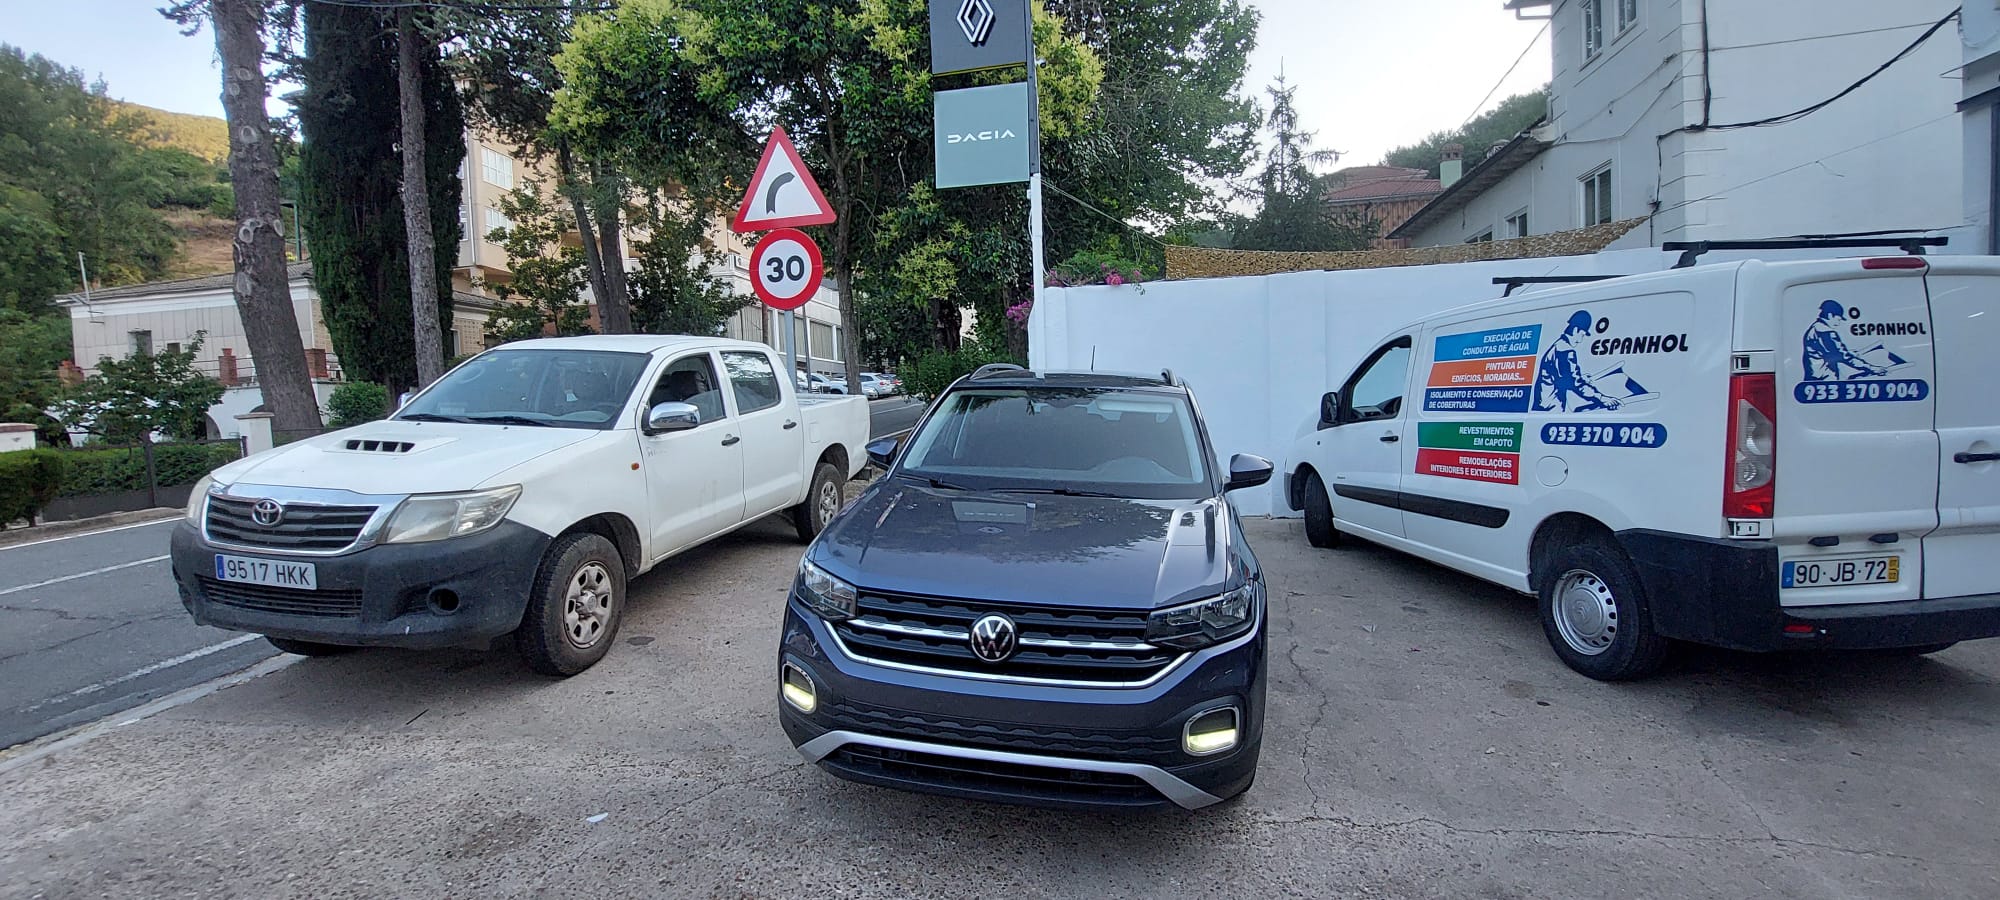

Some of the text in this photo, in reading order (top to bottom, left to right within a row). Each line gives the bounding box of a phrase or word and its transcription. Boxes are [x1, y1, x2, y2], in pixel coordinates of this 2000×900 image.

[948, 129, 1015, 143] DACIA
[766, 255, 805, 283] 30
[1849, 307, 1860, 320] O
[1596, 317, 1609, 333] O
[1850, 322, 1927, 336] ESPANHOL
[1484, 331, 1533, 343] EXECUÇÃO DE
[1463, 342, 1530, 356] CONDUTAS DE ÁGUA
[1591, 334, 1688, 356] ESPANHOL
[1485, 361, 1528, 371] PINTURA DE
[1452, 373, 1525, 383] EDIFÍCIOS, MORADIAS...
[1430, 390, 1466, 399] ISOLAMENTO
[1472, 388, 1523, 400] CONSERVAÇÃO
[1804, 382, 1919, 401] 933 370 904
[1429, 401, 1476, 409] DE COBERTURAS
[1459, 426, 1514, 436] REVESTIMENTOS
[1549, 426, 1655, 445] 933 370 904
[1473, 437, 1513, 447] EM CAPOTO
[1459, 456, 1512, 468] REMODELAÇÕES
[1430, 464, 1512, 480] INTERIORES E EXTERIORES
[227, 559, 310, 586] 9517 HKK
